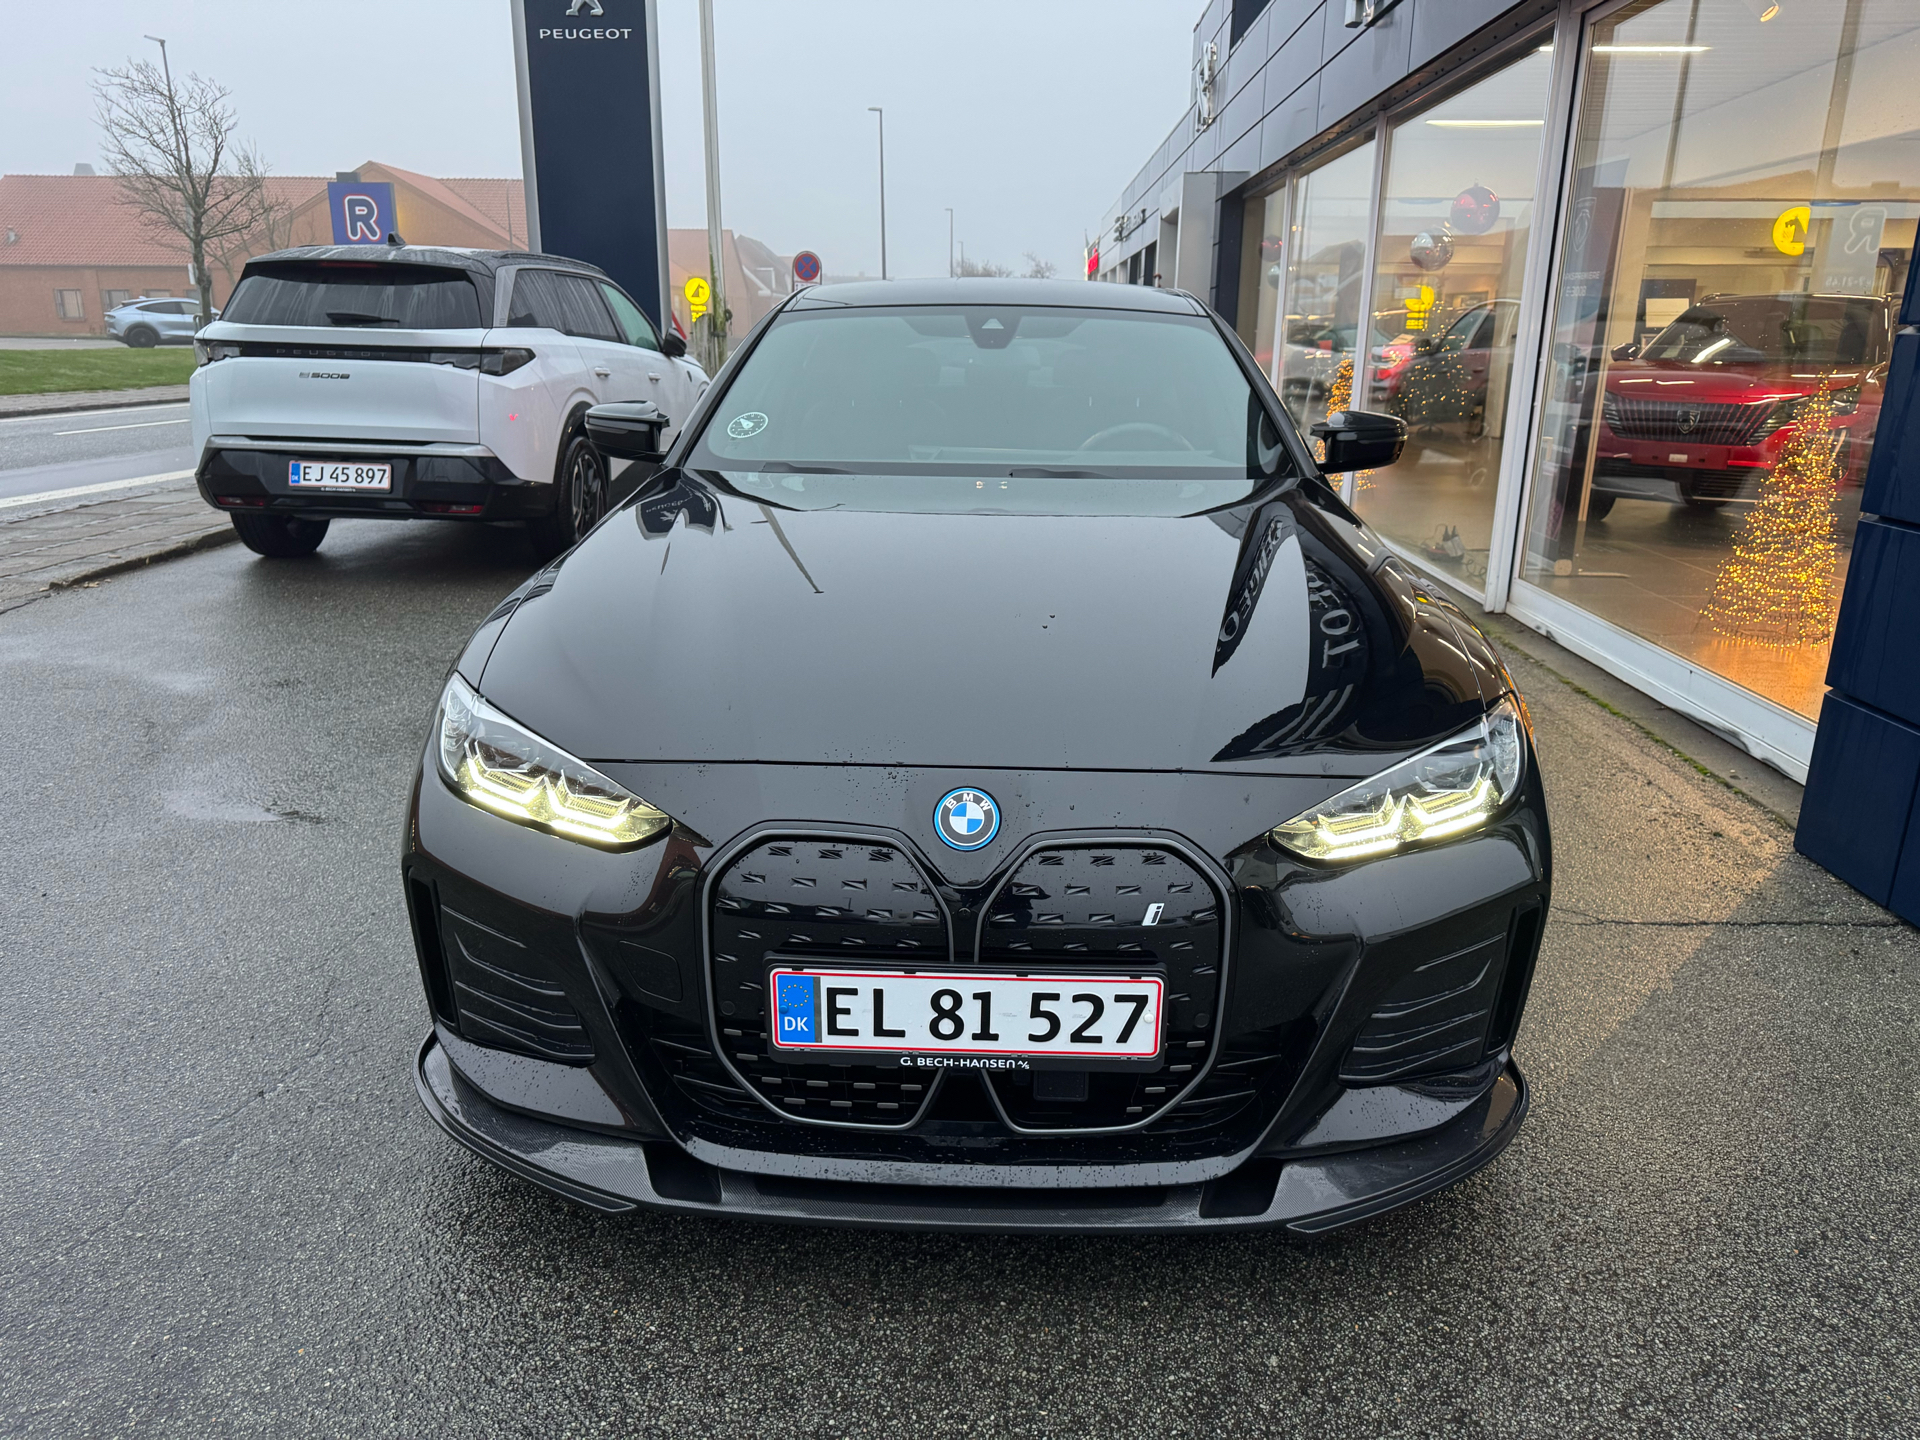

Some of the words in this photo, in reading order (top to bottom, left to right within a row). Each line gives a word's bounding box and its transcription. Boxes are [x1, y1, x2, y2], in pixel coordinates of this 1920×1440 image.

[539, 28, 632, 40] PEUGEOT
[343, 194, 381, 241] R
[276, 348, 387, 357] PEUGEOT
[302, 465, 324, 482] EJ
[329, 466, 350, 483] 45
[354, 467, 387, 485] 897
[945, 793, 991, 811] BMW
[826, 986, 906, 1038] EL
[928, 987, 1000, 1042] 81
[1027, 991, 1150, 1044] 527
[783, 1016, 809, 1032] DK
[900, 1056, 914, 1066] G.
